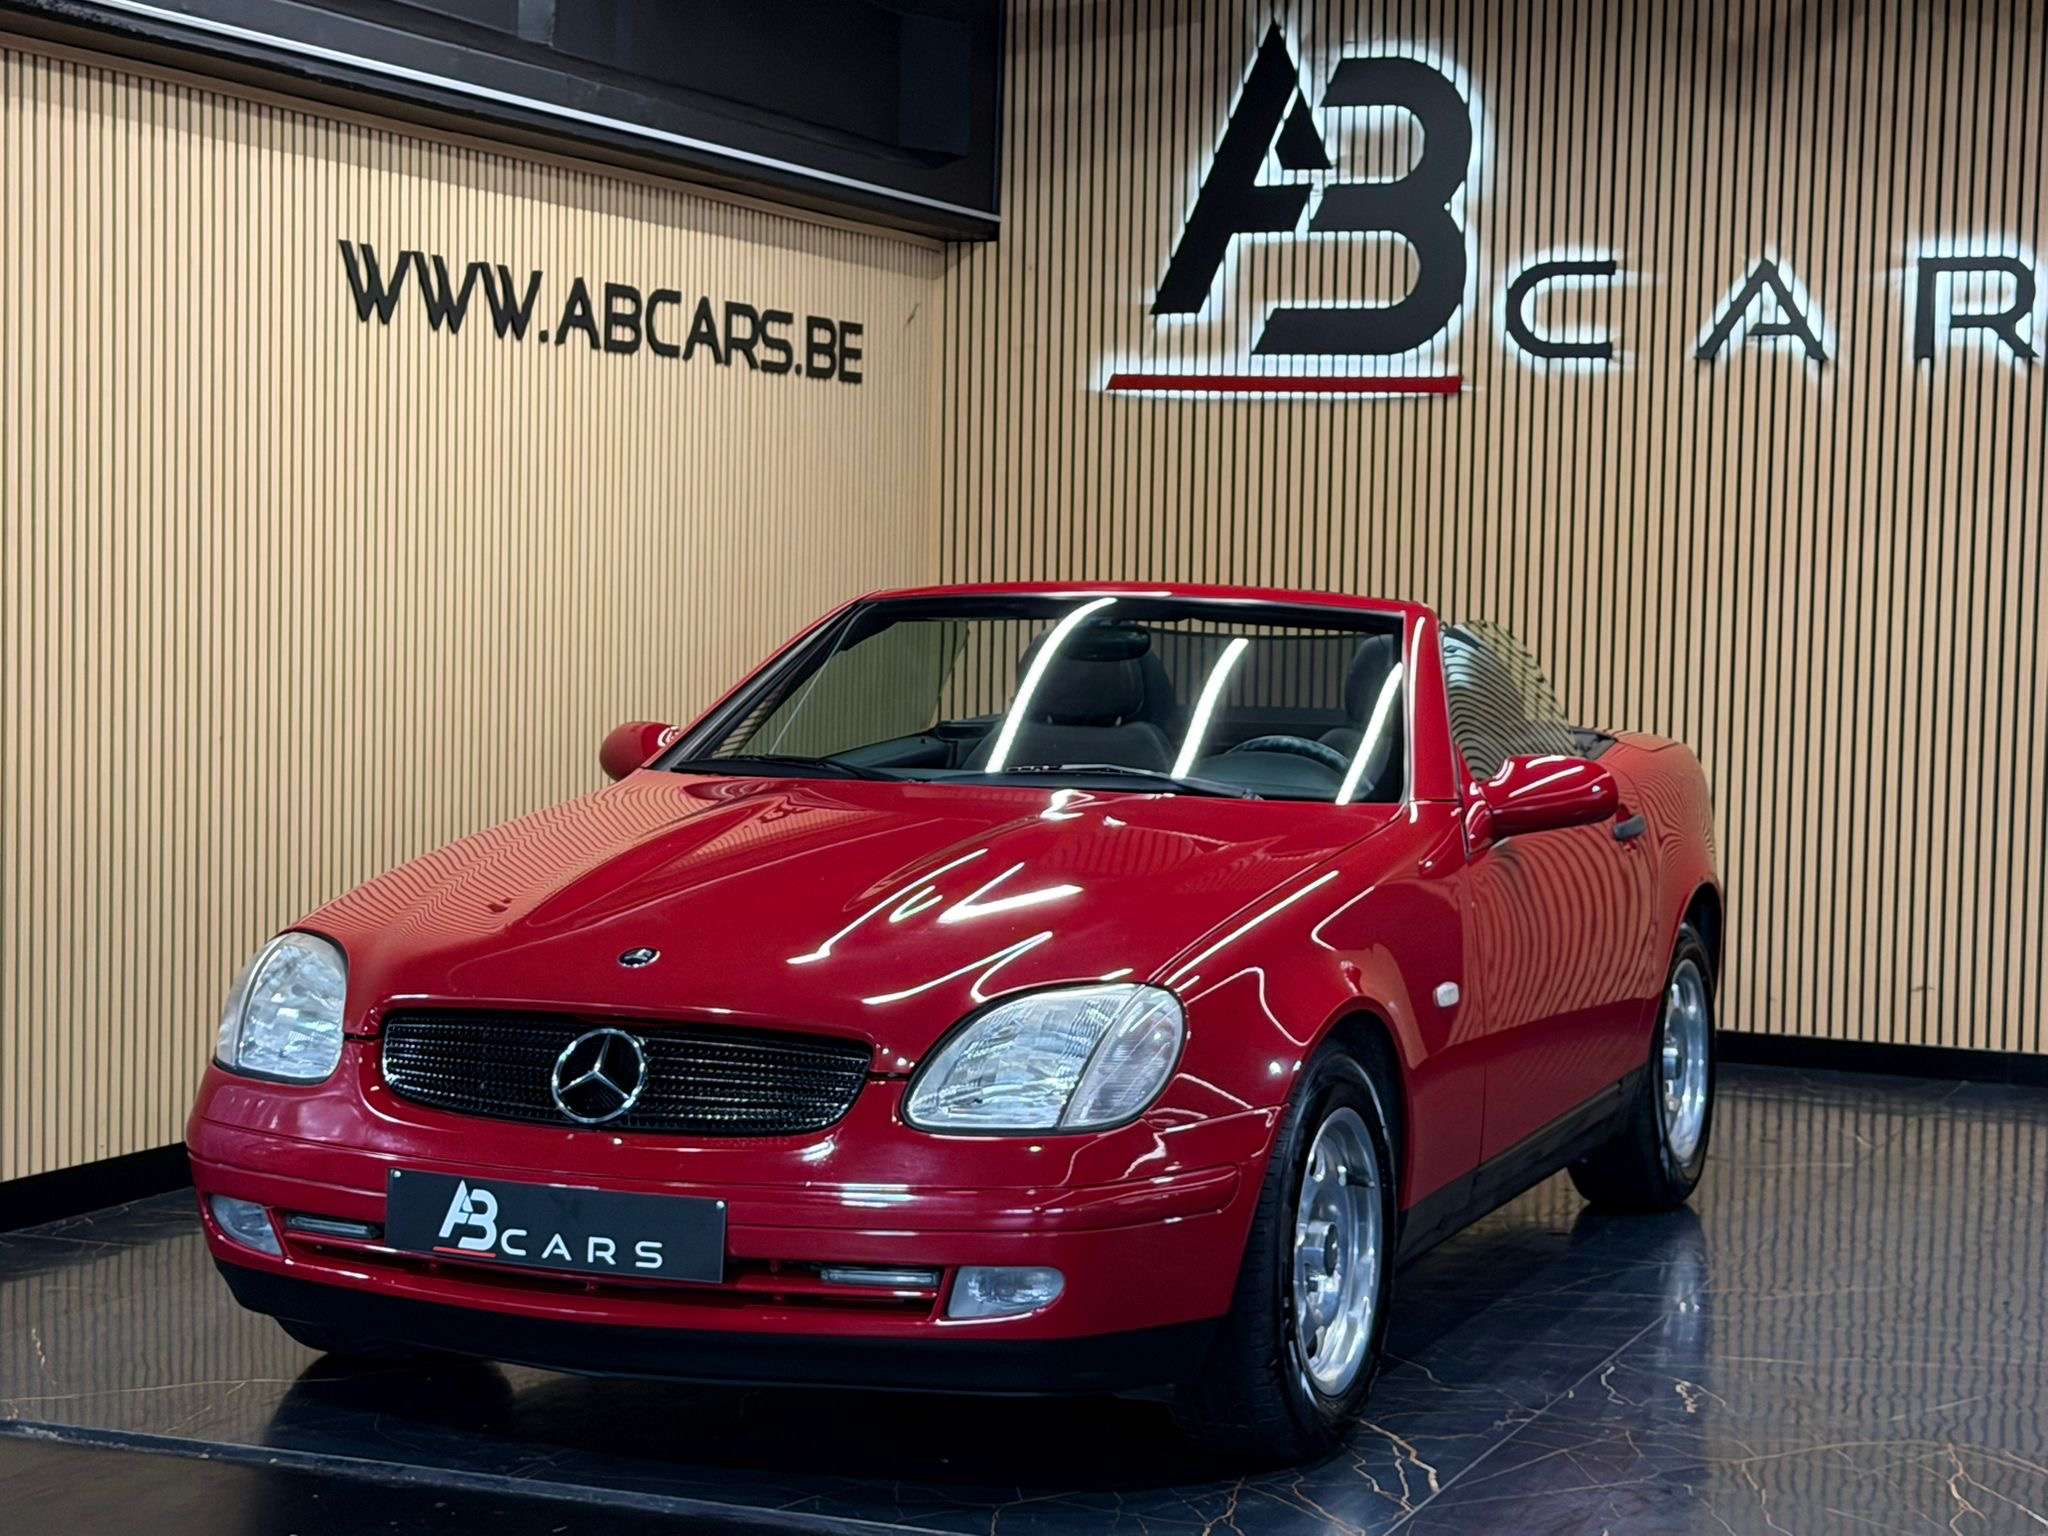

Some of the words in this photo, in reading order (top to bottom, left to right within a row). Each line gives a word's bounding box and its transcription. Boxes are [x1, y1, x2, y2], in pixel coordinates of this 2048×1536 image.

[338, 239, 864, 383] WWW.ABCARS.BE
[1506, 255, 2041, 362] CAR
[501, 1228, 663, 1269] CARS
